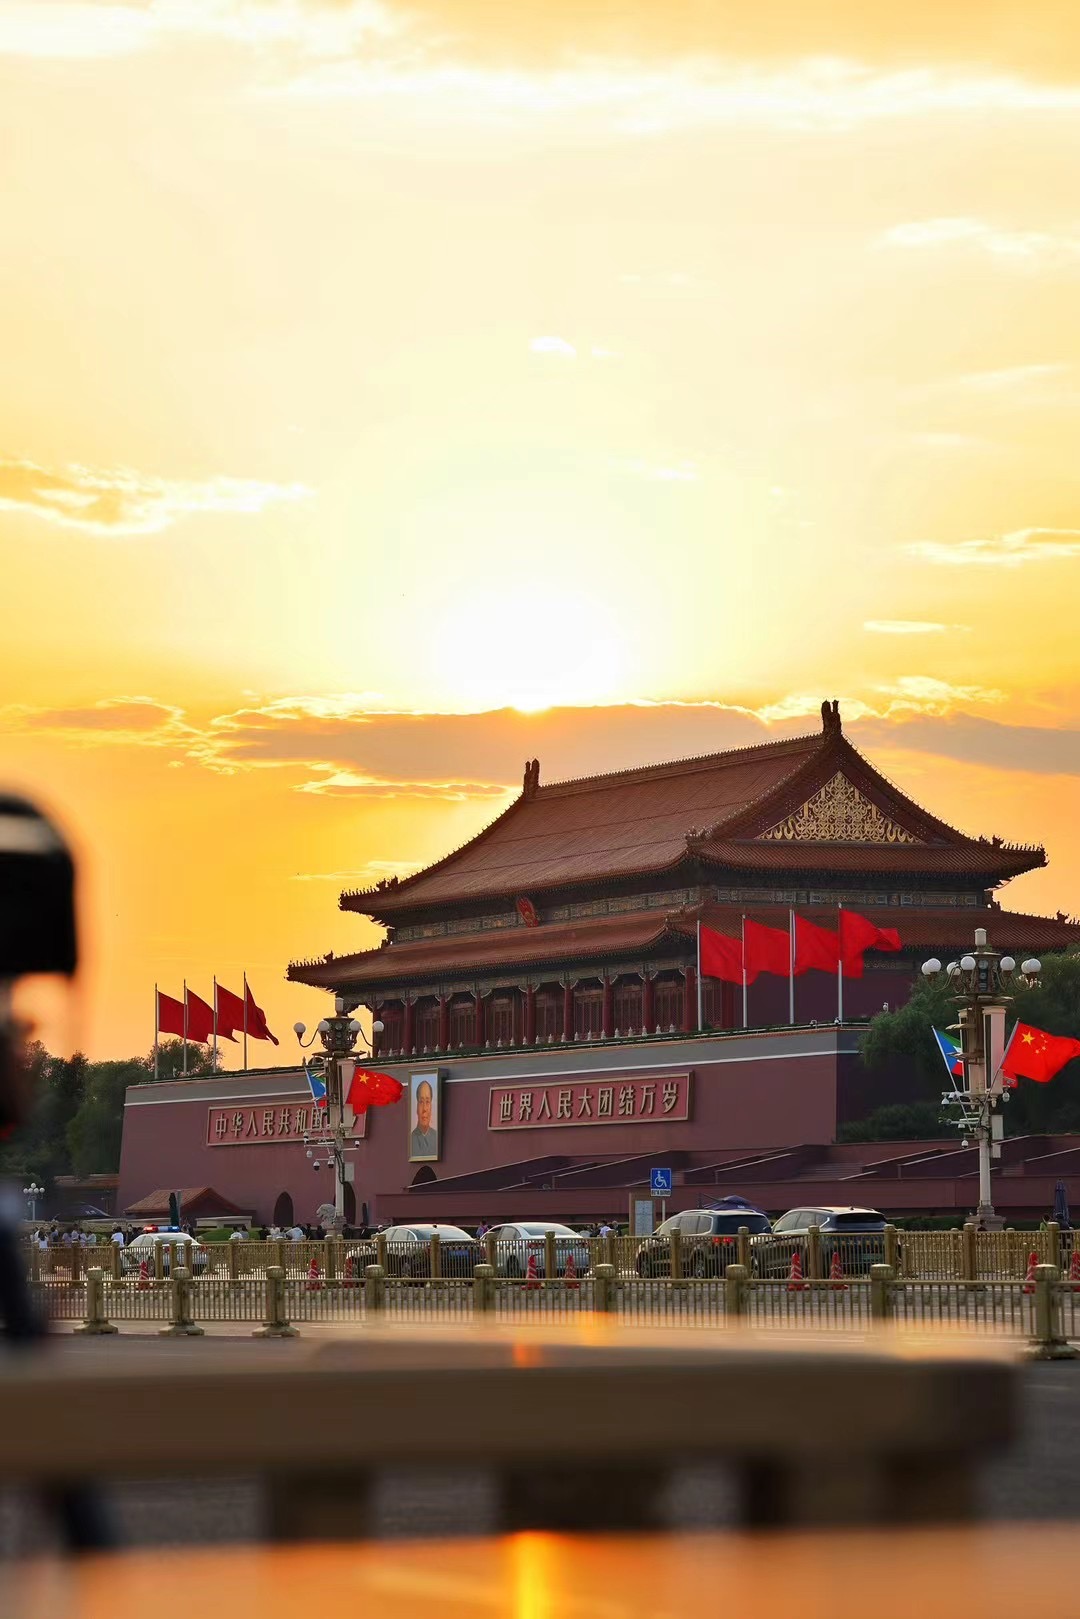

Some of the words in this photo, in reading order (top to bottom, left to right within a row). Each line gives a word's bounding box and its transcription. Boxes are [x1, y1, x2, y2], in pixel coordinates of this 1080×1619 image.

[499, 1082, 678, 1122] 世界人民大团结万岁
[215, 1106, 356, 1139] 中华人民共和国
